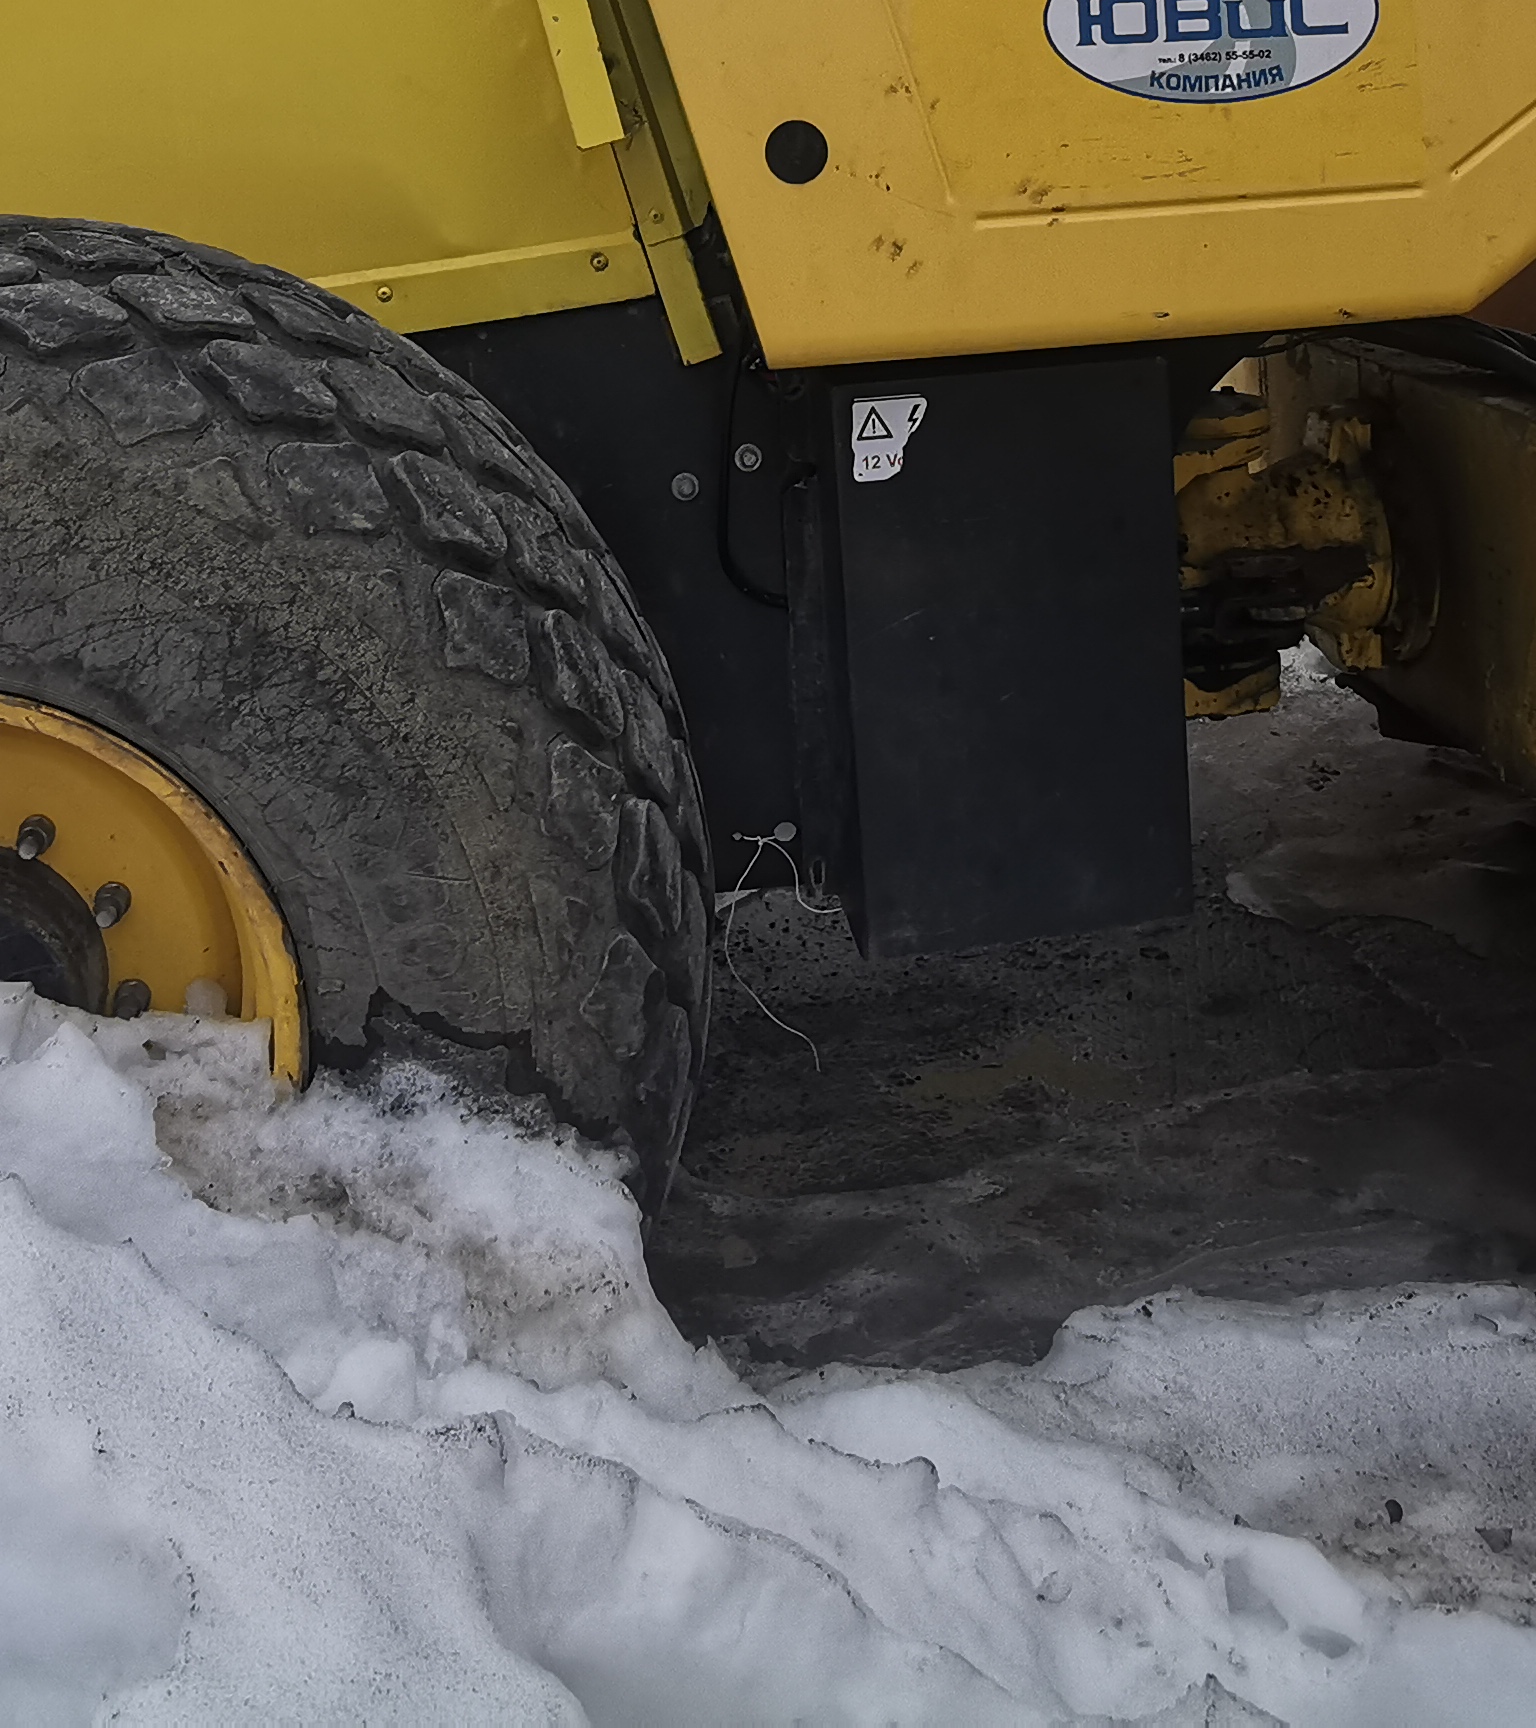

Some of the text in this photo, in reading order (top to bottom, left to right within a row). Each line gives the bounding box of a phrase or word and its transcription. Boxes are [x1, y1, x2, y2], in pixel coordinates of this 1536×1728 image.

[1178, 53, 1185, 62] 8
[1225, 49, 1272, 61] 55-55-02
[1149, 63, 1285, 93] КОМПАНИЯ
[862, 454, 881, 470] 12
